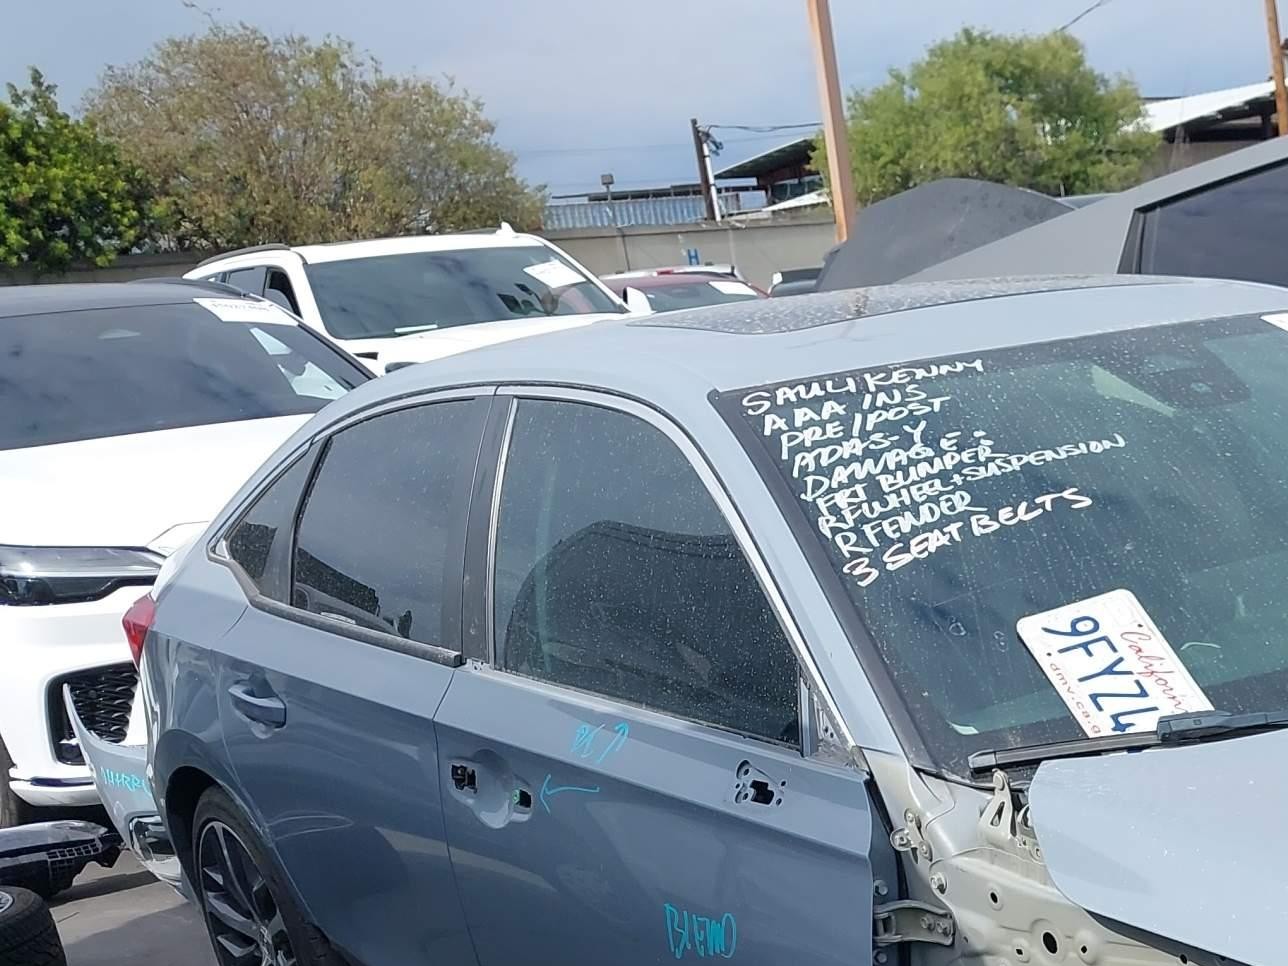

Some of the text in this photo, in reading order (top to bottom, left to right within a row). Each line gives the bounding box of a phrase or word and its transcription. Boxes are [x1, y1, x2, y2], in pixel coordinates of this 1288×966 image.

[763, 400, 848, 436] AAA
[842, 487, 1093, 588] 3 SEAT BELTS
